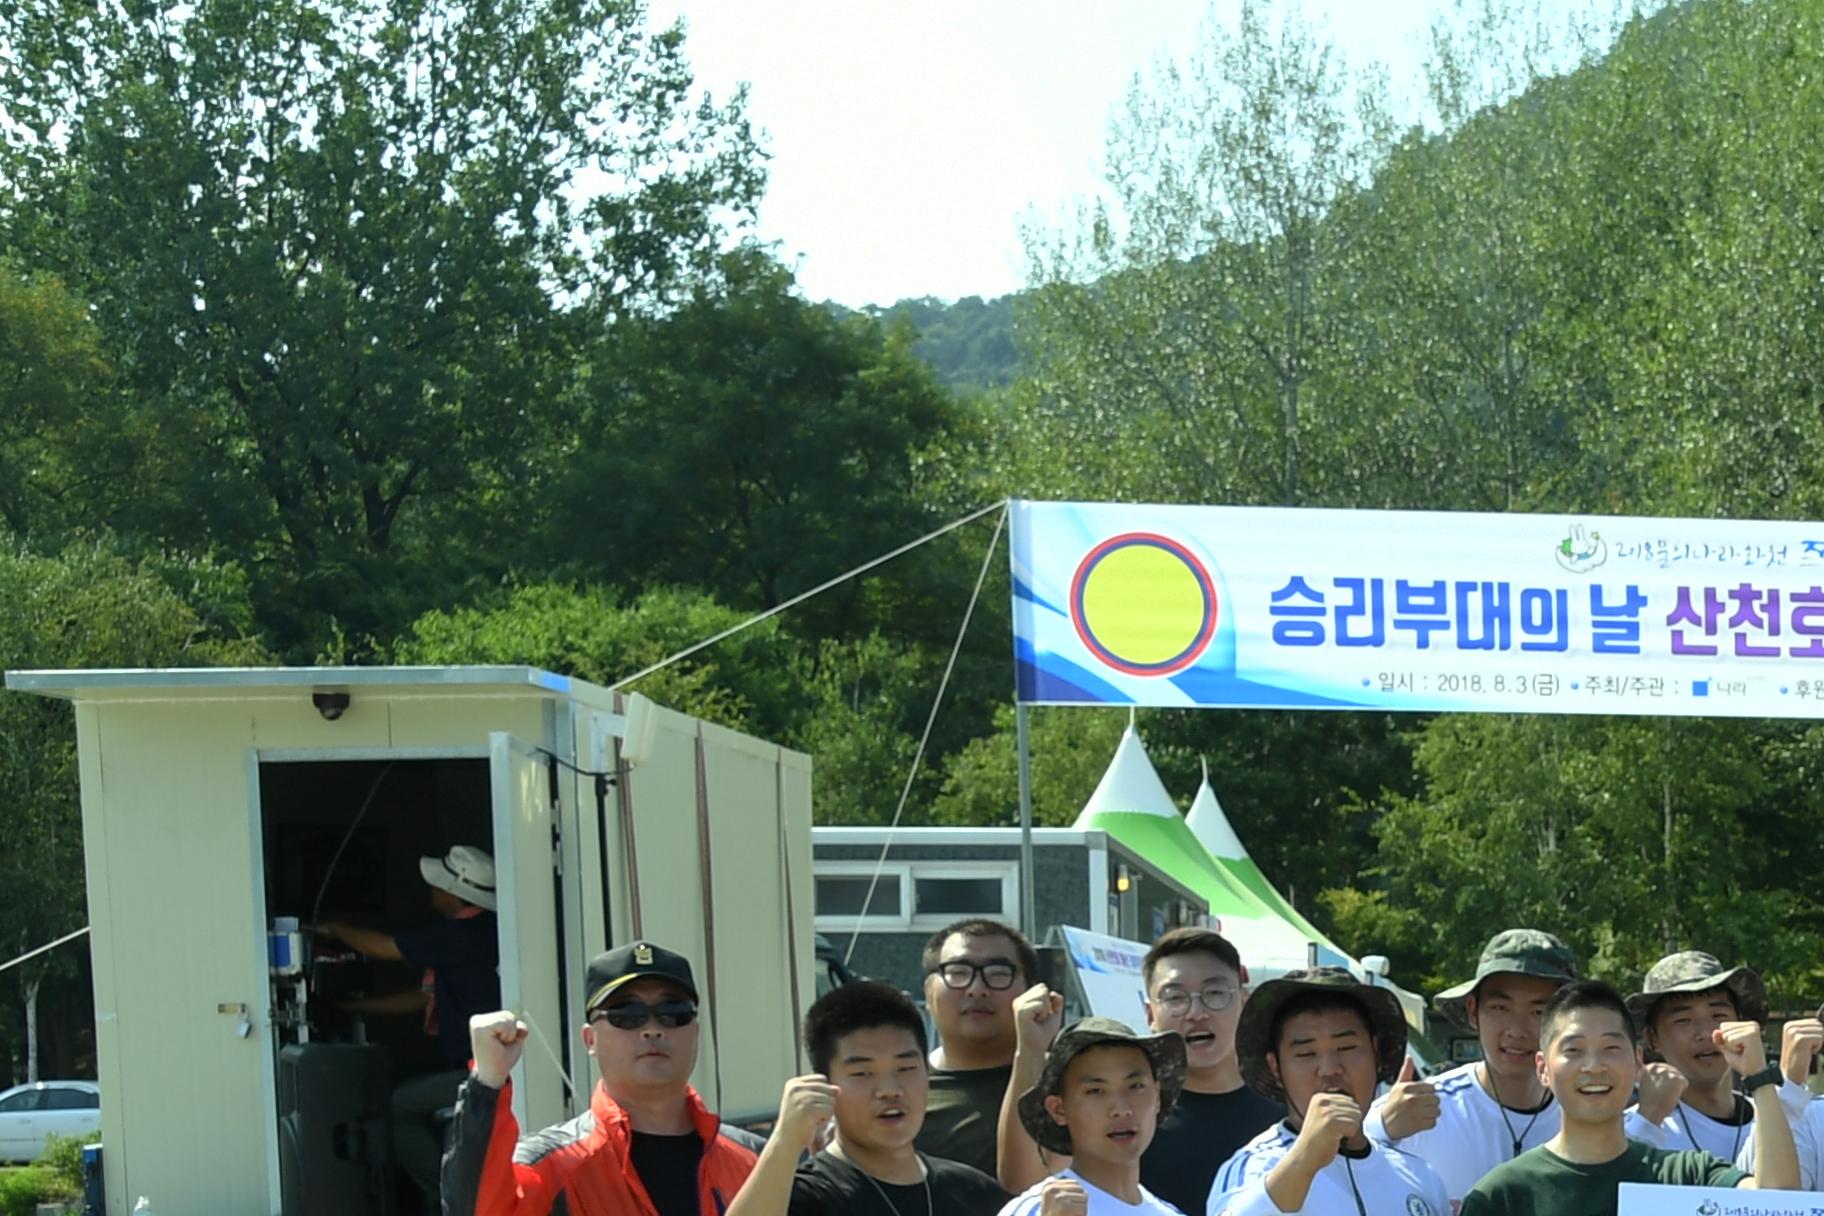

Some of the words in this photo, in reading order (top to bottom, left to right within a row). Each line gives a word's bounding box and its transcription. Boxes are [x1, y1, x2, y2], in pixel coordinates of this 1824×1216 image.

[1269, 575, 1568, 653] 승리부대의
[1589, 584, 1648, 656] 날
[1377, 671, 1415, 693] 일시
[1584, 674, 1665, 698] 주최/주관
